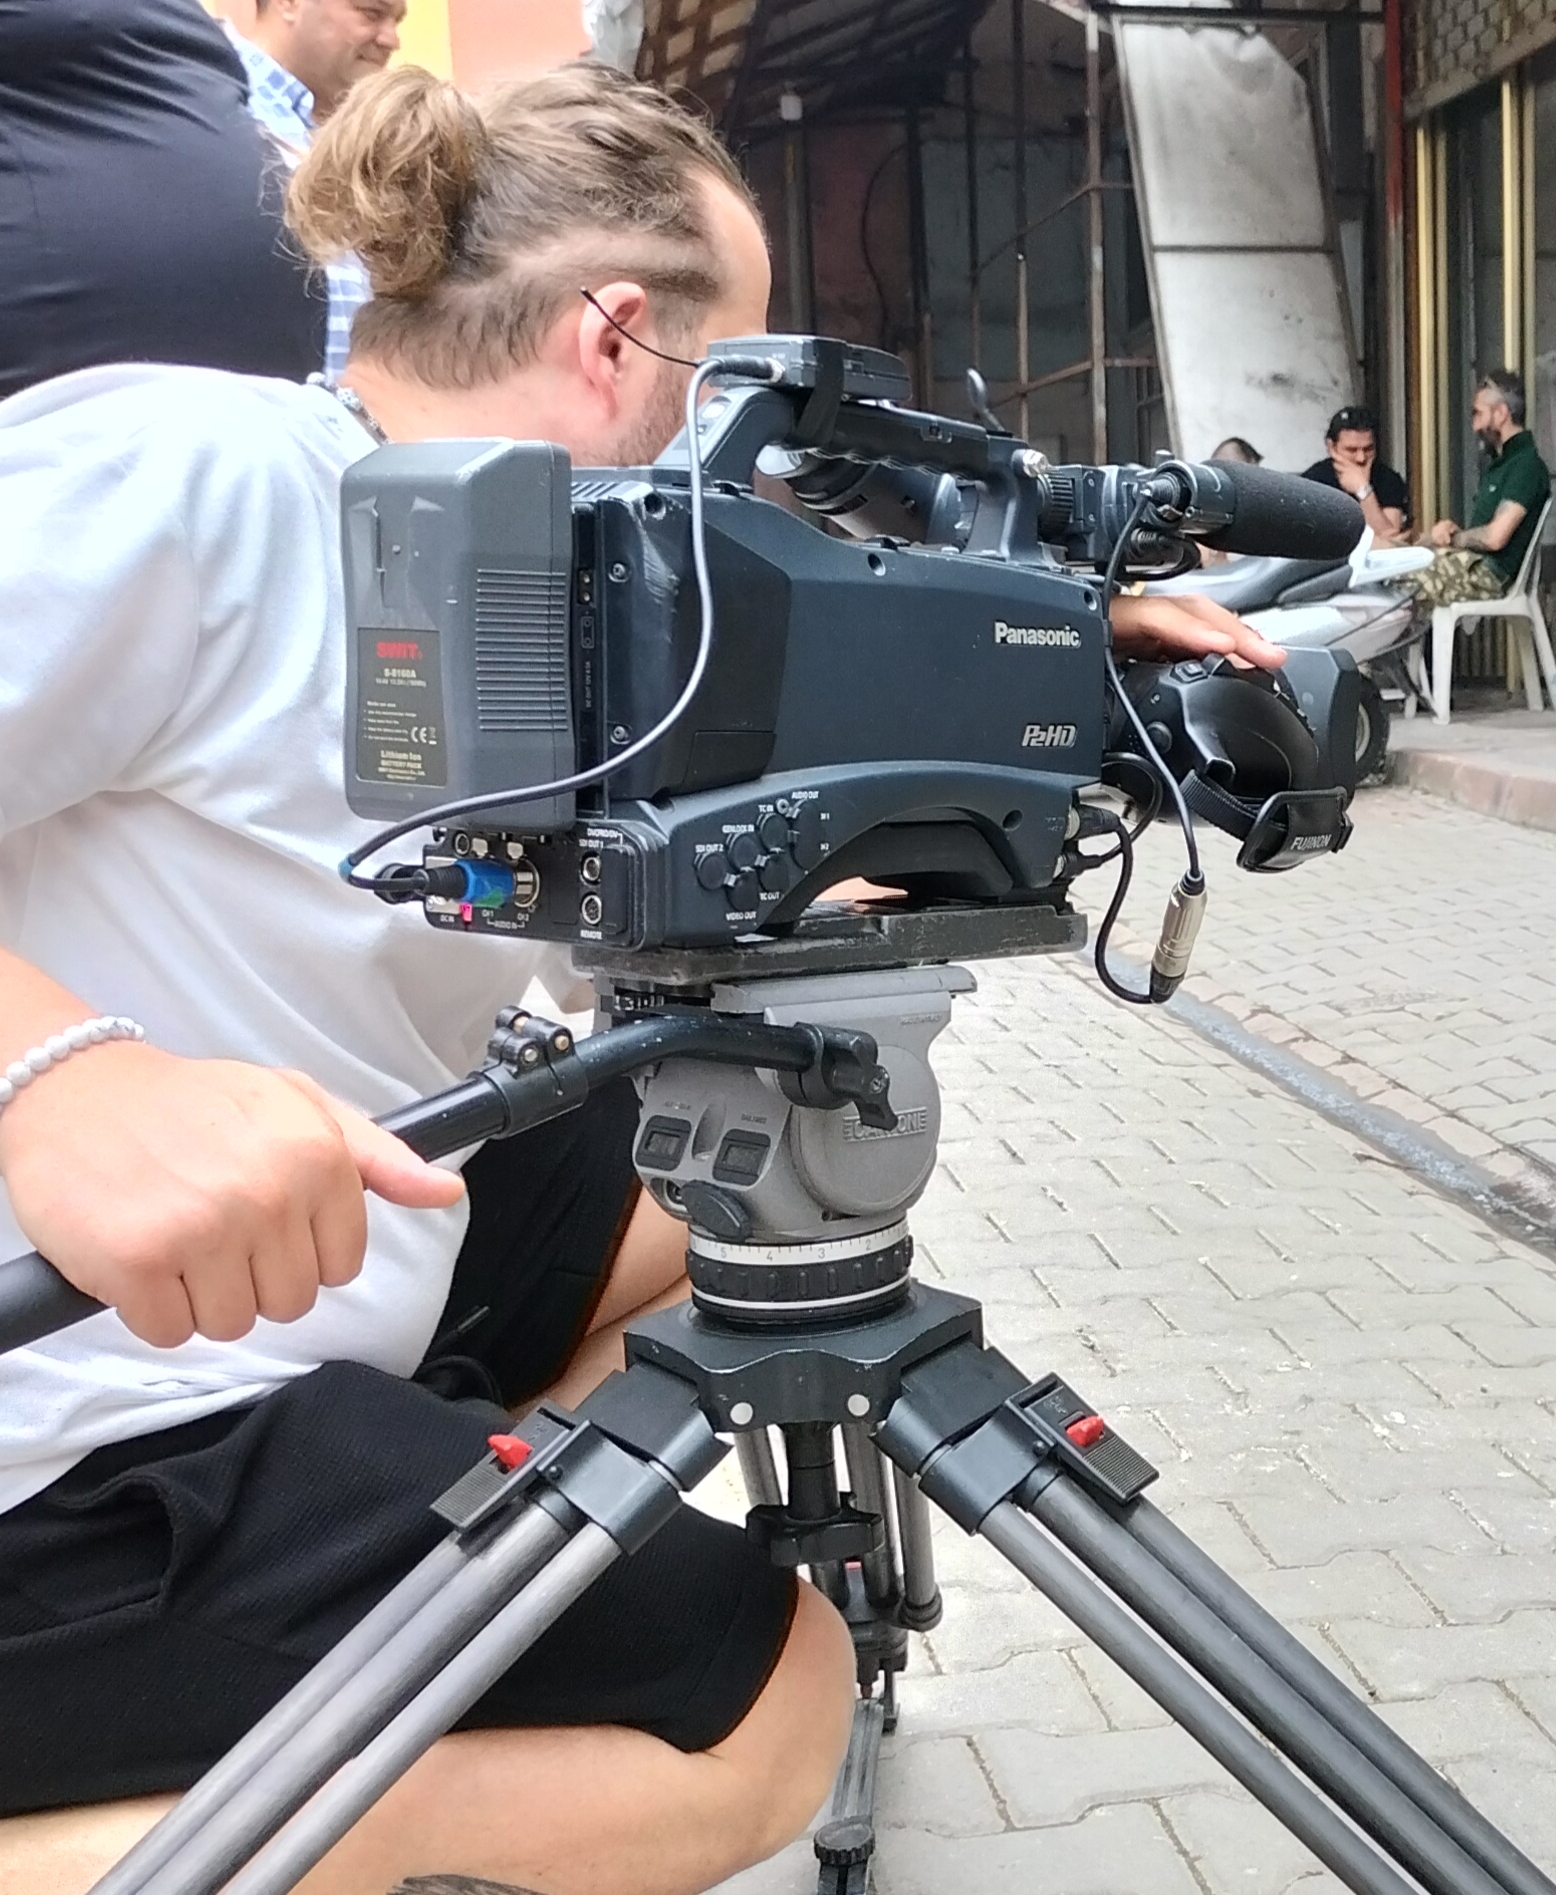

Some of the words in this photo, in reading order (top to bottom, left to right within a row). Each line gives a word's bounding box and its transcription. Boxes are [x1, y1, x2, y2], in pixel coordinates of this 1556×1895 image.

[994, 621, 1080, 646] Panasonic
[1022, 724, 1078, 747] P2HD
[1291, 834, 1332, 851] FUJINON
[720, 1247, 727, 1259] 5
[766, 1250, 774, 1262] 4
[817, 1247, 826, 1259] 3
[865, 1238, 872, 1251] 2
